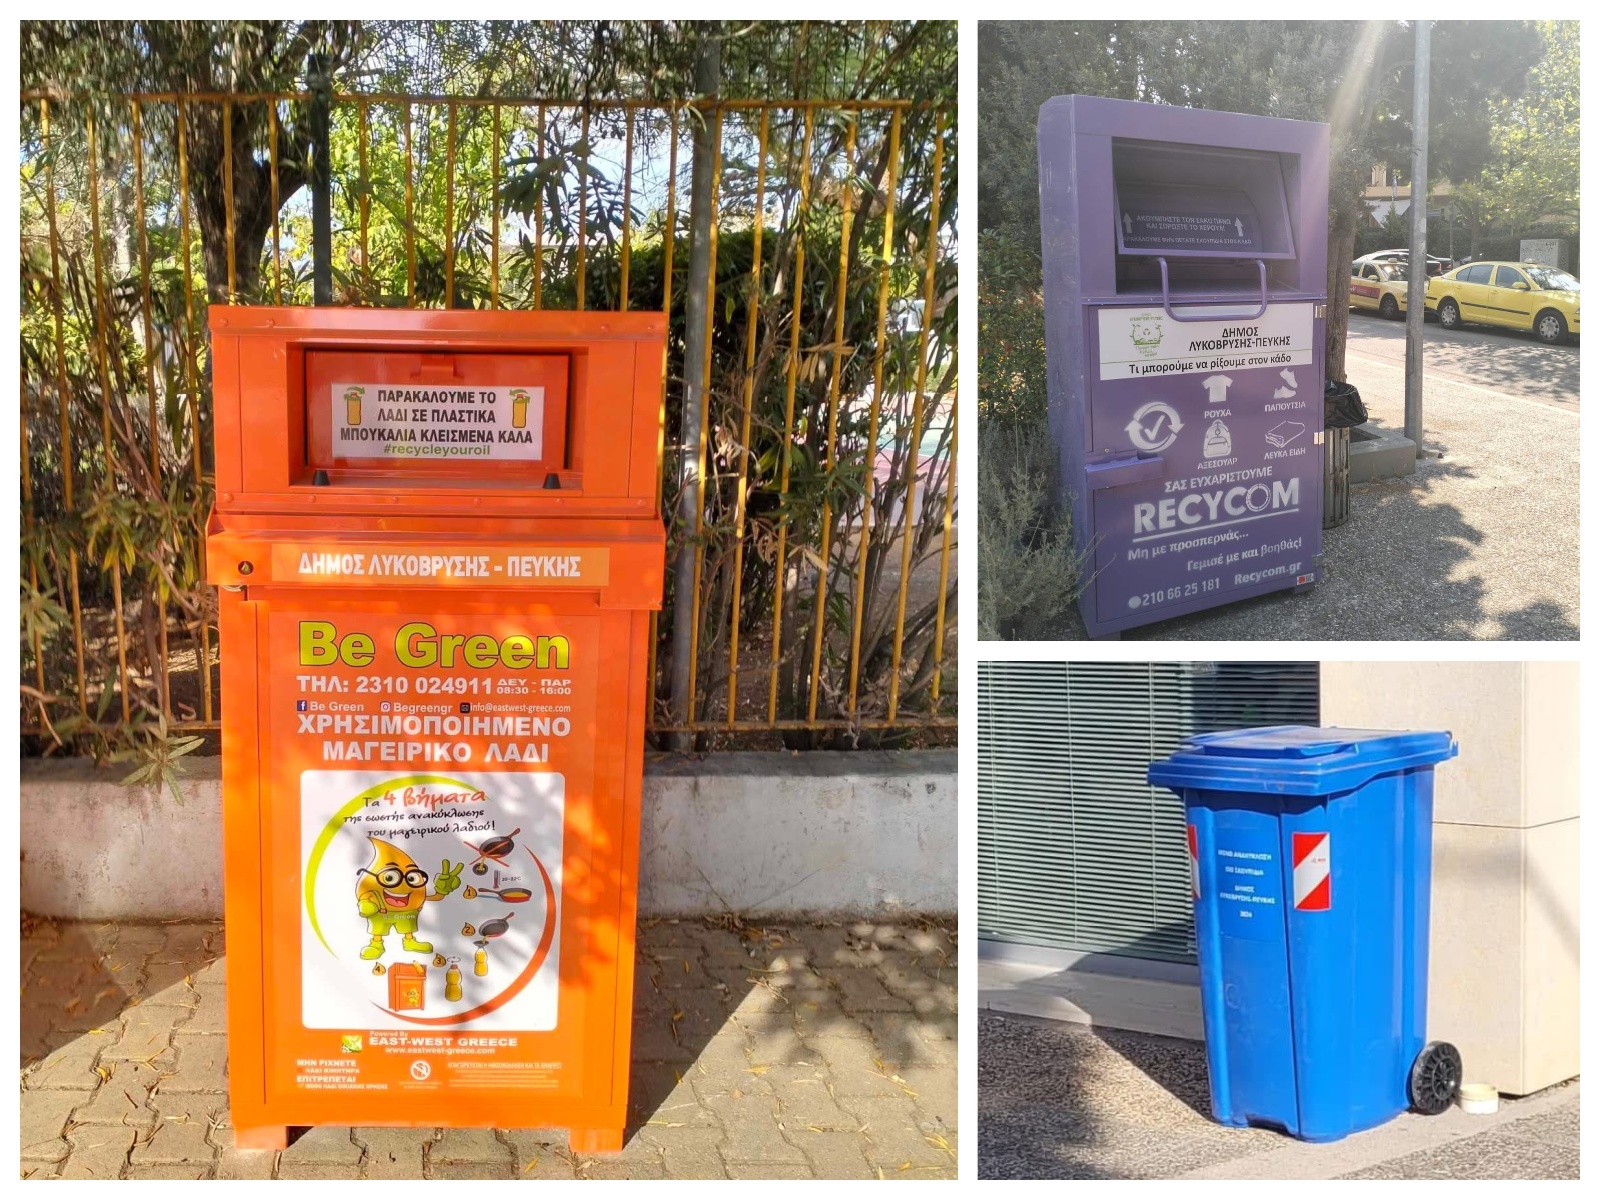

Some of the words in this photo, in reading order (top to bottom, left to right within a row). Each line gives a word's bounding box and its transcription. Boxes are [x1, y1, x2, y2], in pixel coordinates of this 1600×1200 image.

[1222, 327, 1258, 338] ΔΗΜΟΣ
[1188, 336, 1291, 352] ΛΥΚΟΒΡΥΣΗΣ-ΠΕΥΚΗΣ
[1129, 364, 1140, 374] Τι
[1142, 361, 1194, 374] μπορούμε
[1196, 360, 1208, 369] να
[1210, 356, 1246, 369] ρίξουμε
[1248, 356, 1268, 365] στον
[1270, 354, 1291, 363] κάδο
[378, 390, 475, 404] ΠΑΡΑΚΑΛΟΥΜΕ
[479, 392, 496, 404] ΤΟ
[1204, 409, 1232, 418] ΡΟΥΧΑ
[1264, 401, 1306, 412] ΠΑΠΟΥΤΣΙΑ
[377, 408, 408, 422] ΛΑΔΙ
[412, 409, 427, 422] ΣΕ
[431, 409, 496, 423] ΠΛΑΣΤΙΚΑ
[340, 428, 417, 442] ΜΠΟΥΚΑΛΙΑ
[420, 429, 494, 443] ΚΛΕΙΣΜΕΝΑ
[498, 430, 533, 444] ΚΑΛΑ
[383, 444, 490, 457] #recycleyouroil
[1264, 450, 1288, 460] ΛΕΥΚΑ
[1289, 447, 1306, 456] ΕΙΔΗ
[1198, 458, 1238, 470] ΑΞΕΣΟΥΑΡ
[1165, 479, 1187, 493] ΣΑΣ
[1190, 466, 1273, 488] ΕΥΧΑΡΙΣΤΟΥΜΕ
[1134, 478, 1299, 534] RECYCOM
[1128, 549, 1148, 561] Μη
[1152, 545, 1167, 558] με
[1187, 553, 1223, 571] Γεμισέ
[1226, 553, 1239, 565] με
[1242, 549, 1259, 560] και
[1261, 537, 1302, 557] βοηθάς!
[298, 552, 365, 575] ΔΗΜΟΣ
[368, 555, 490, 576] ΛΥΚΟΒΡΥΣΗΣ
[507, 556, 581, 577] ΠΕΥΚΗΣ
[1235, 562, 1302, 585] Recycom.gr
[1142, 590, 1164, 606] 210
[1167, 587, 1181, 600] 66
[1184, 583, 1198, 596] 25
[1202, 578, 1220, 592] 181
[299, 621, 375, 668] Be
[395, 622, 570, 669] Green
[297, 676, 349, 693] ΤΗΛ:
[356, 676, 408, 694] 2310
[415, 677, 492, 694] 024911
[497, 678, 528, 686] ΔΕΥ
[540, 687, 571, 695] 16:00
[310, 701, 325, 711] Be
[329, 702, 364, 712] Green
[394, 702, 452, 714] Begreengr
[470, 702, 571, 713] info@eastwest-greece.com
[297, 714, 570, 736] ΧΡΗΣΙΜΟΠΟΙΗΜΕΝΟ
[323, 741, 472, 762] ΜΑΓΕΙΡΙΚΟ
[484, 743, 548, 762] ΛΑΔΙ
[363, 798, 380, 807] Τα
[384, 790, 396, 805] 4
[403, 787, 486, 811] βήματα
[365, 811, 404, 822] σωστής
[408, 808, 484, 820] ανακύκλωσης
[367, 829, 386, 837] του
[389, 824, 450, 839] μαγειρικού
[452, 821, 495, 833] λαδιού!
[369, 1038, 453, 1046] EAST-WEST
[458, 1038, 517, 1046] GREECE
[385, 1047, 495, 1055] www.eastwest-greece.com
